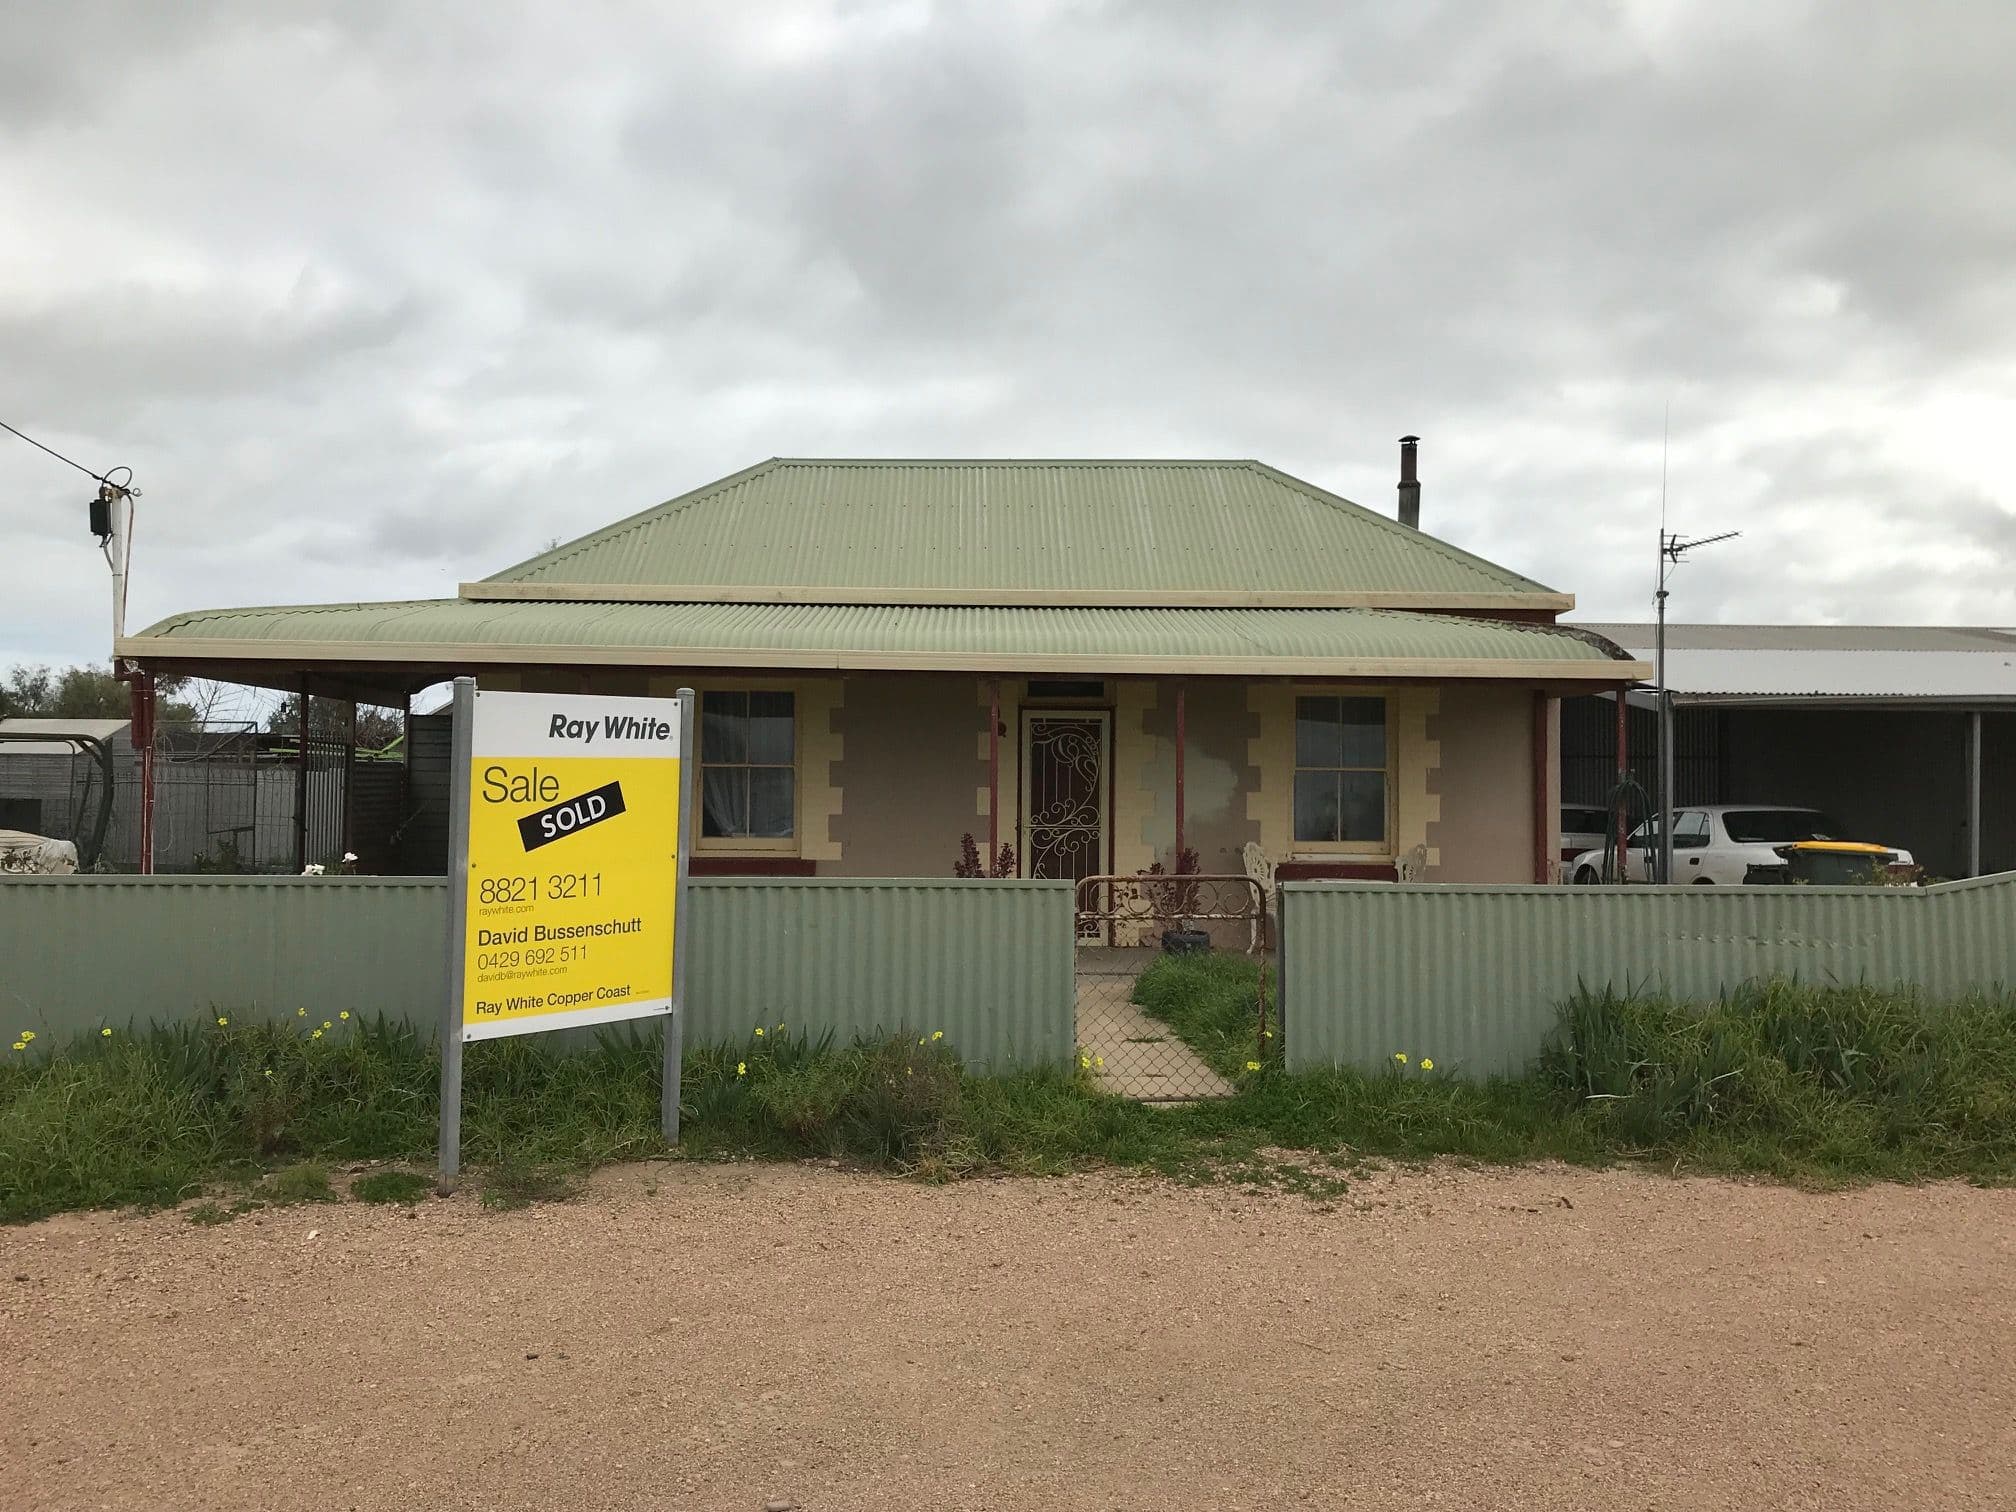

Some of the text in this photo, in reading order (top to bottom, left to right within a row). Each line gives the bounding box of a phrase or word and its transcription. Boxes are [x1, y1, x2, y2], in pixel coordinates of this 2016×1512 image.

[549, 714, 671, 743] Ray White
[482, 766, 560, 803] Sale
[540, 795, 606, 838] SOLD
[480, 873, 601, 904] 8821 3211
[479, 904, 535, 917] raywhite.com
[478, 918, 642, 946] David Bussenschutt
[477, 945, 587, 970] 0429 692 511
[477, 966, 568, 983] davidb@raywhite.com
[476, 1001, 502, 1016] Ray
[506, 996, 544, 1010] White
[547, 991, 593, 1007] Copper
[596, 985, 631, 999] Coast
